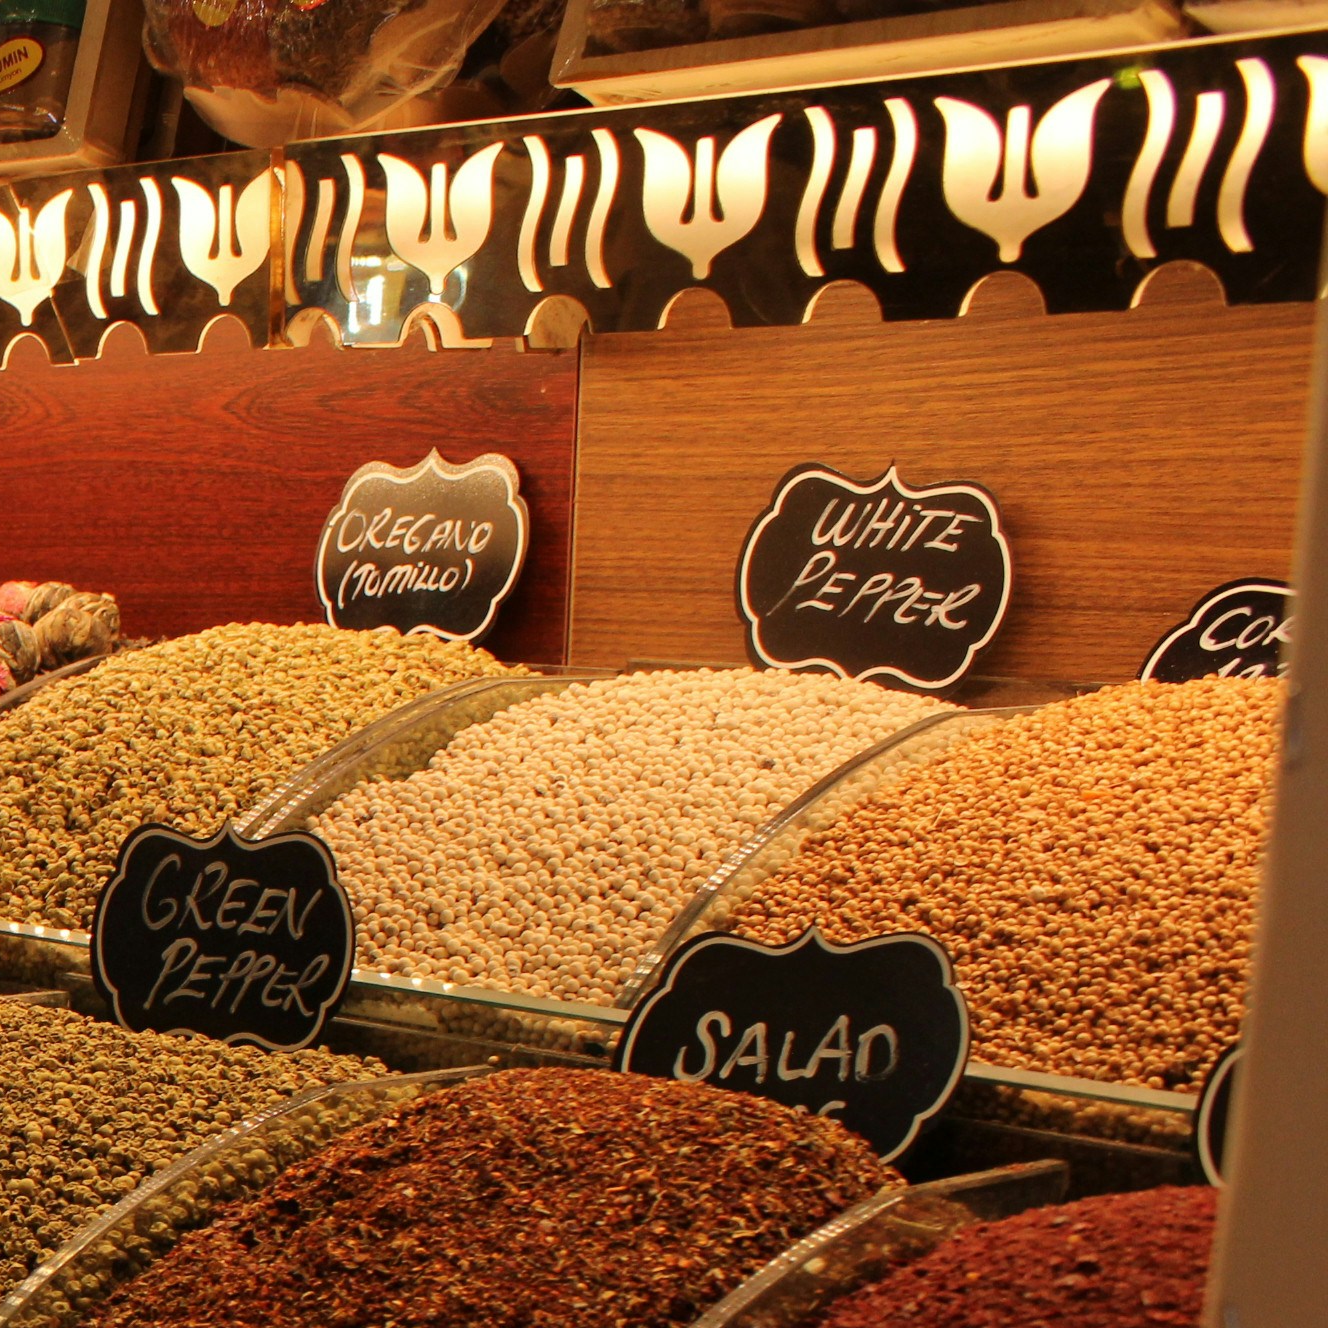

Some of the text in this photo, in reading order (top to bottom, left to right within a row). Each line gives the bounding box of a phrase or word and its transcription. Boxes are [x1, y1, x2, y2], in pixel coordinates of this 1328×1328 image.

[337, 507, 493, 554] OREGANO
[767, 550, 982, 631] PEPPER
[1199, 606, 1295, 652] COR
[142, 853, 323, 940] GREEN
[143, 937, 330, 1018] PEPPER
[673, 1010, 899, 1083] SALAD
